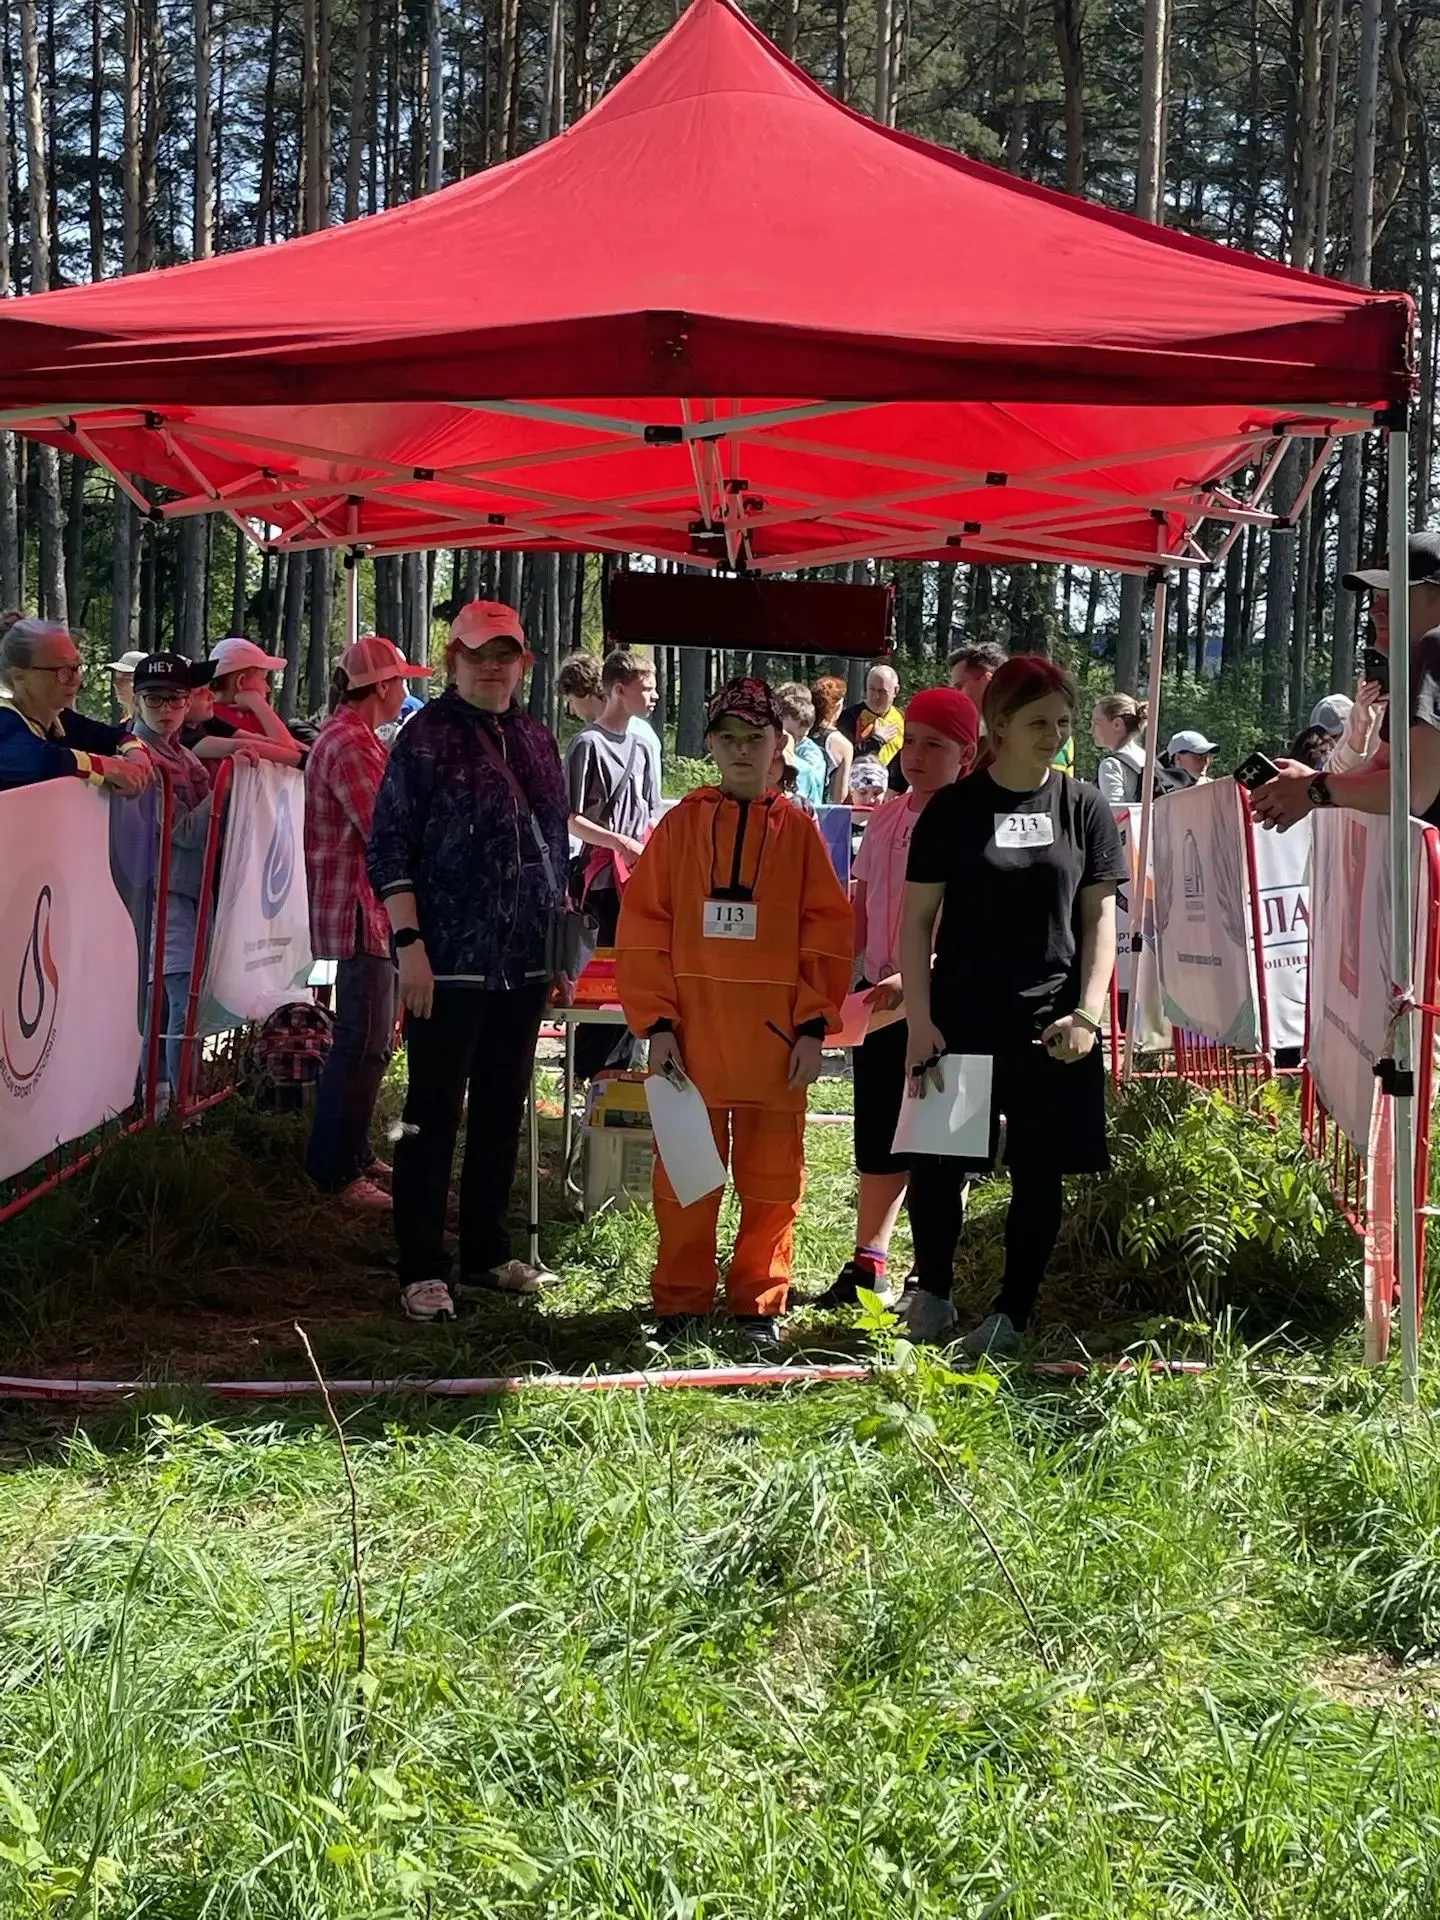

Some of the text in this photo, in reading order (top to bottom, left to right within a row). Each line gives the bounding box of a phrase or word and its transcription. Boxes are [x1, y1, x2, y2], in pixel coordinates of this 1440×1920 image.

[148, 661, 173, 673] HEY
[1008, 817, 1038, 831] 213
[716, 906, 744, 922] 113
